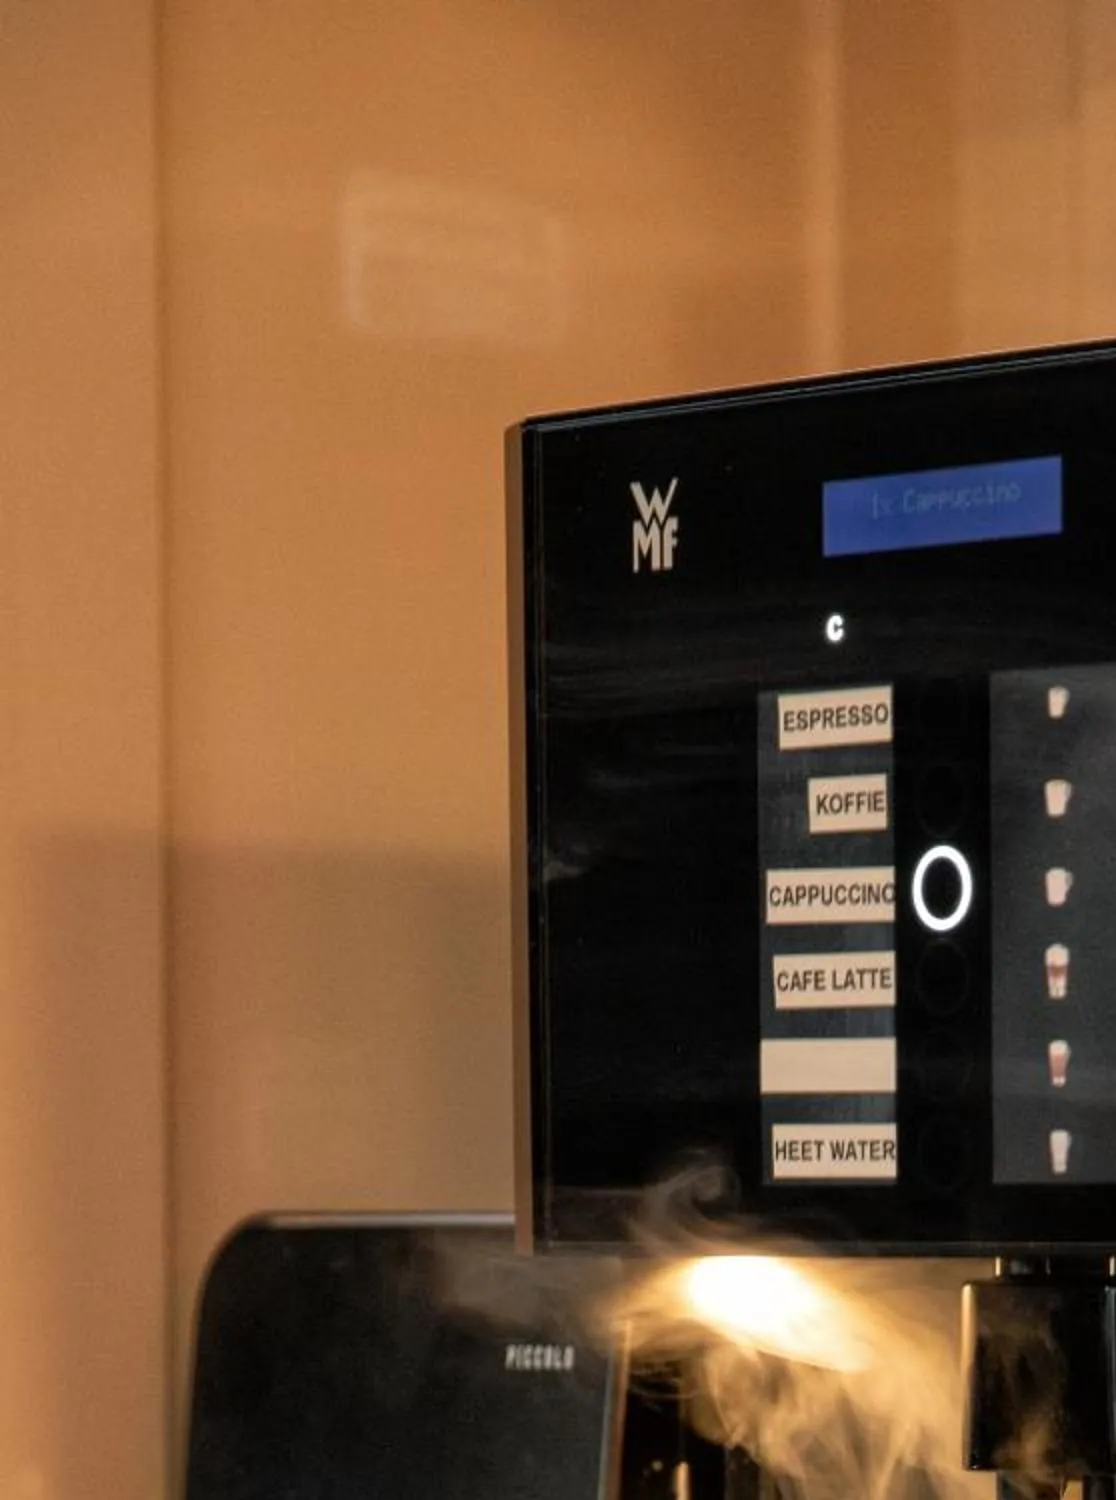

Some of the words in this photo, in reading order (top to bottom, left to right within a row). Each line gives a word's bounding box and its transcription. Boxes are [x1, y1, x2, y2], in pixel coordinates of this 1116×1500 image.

[782, 704, 890, 731] ESPRESSO
[815, 789, 886, 815] KOFFIE
[768, 881, 896, 907] CAPPUCCINO
[776, 967, 826, 993] CAFE
[831, 966, 893, 991] LATTE
[775, 1139, 824, 1162] HEET
[829, 1139, 896, 1161] WATER
